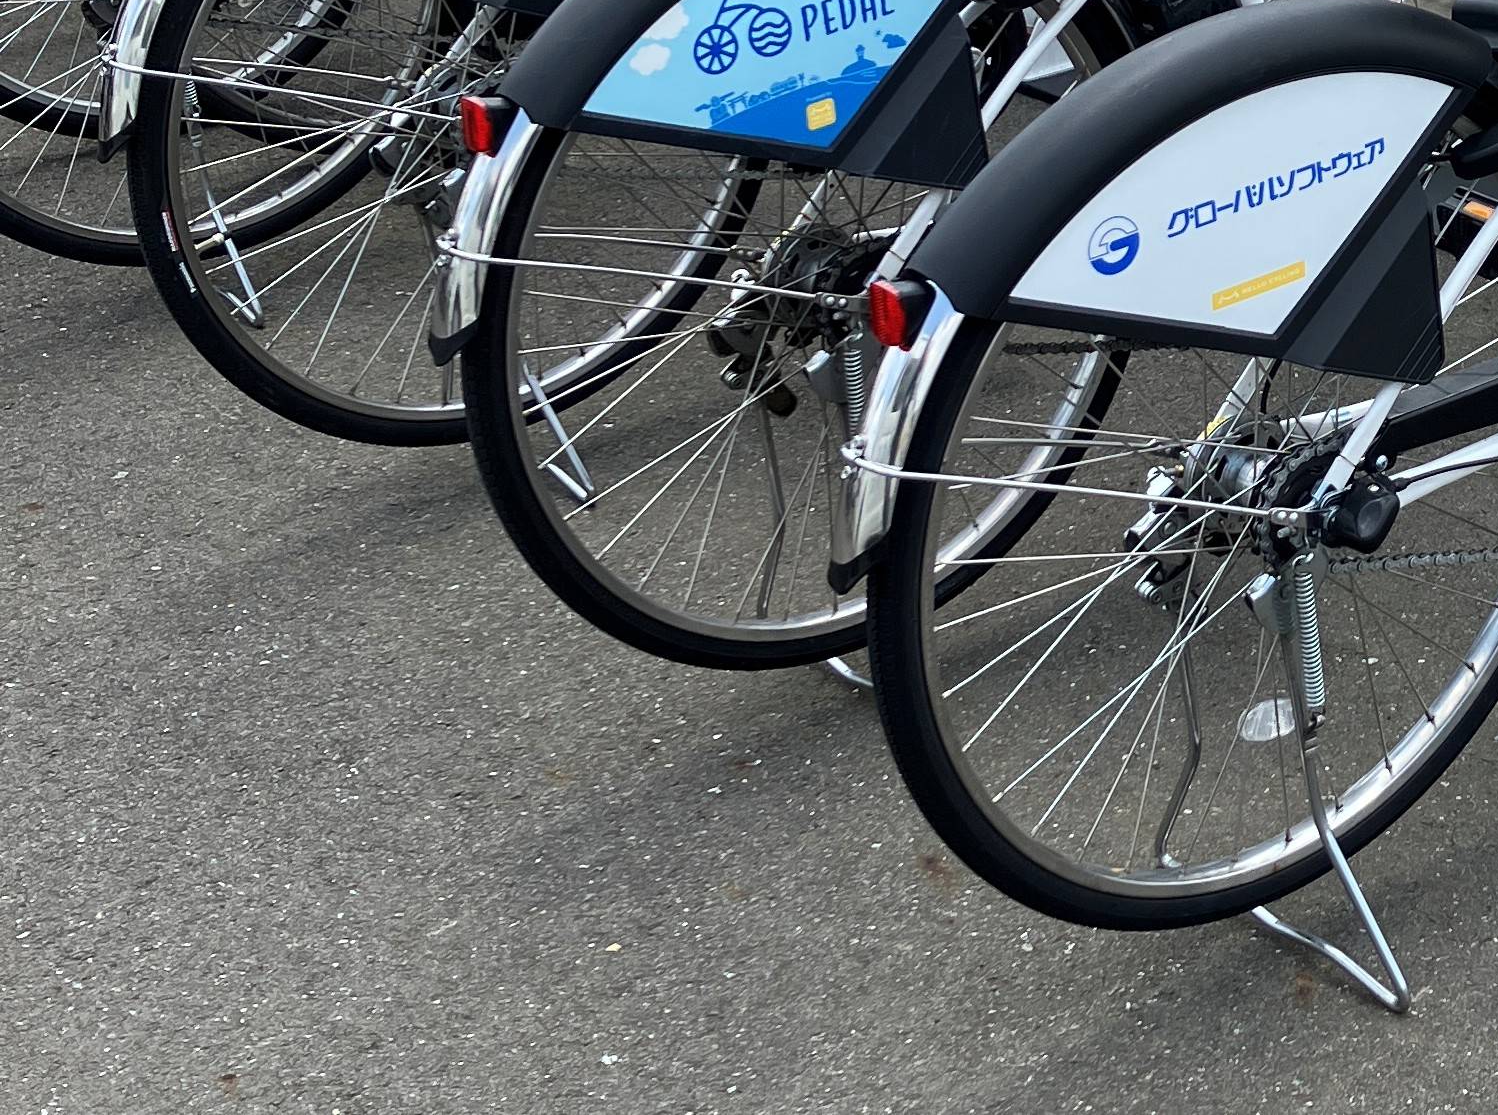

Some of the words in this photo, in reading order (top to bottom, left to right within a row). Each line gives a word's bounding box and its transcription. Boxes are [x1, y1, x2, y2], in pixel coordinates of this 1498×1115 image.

[1166, 136, 1386, 239] グローバルソフトウェア
